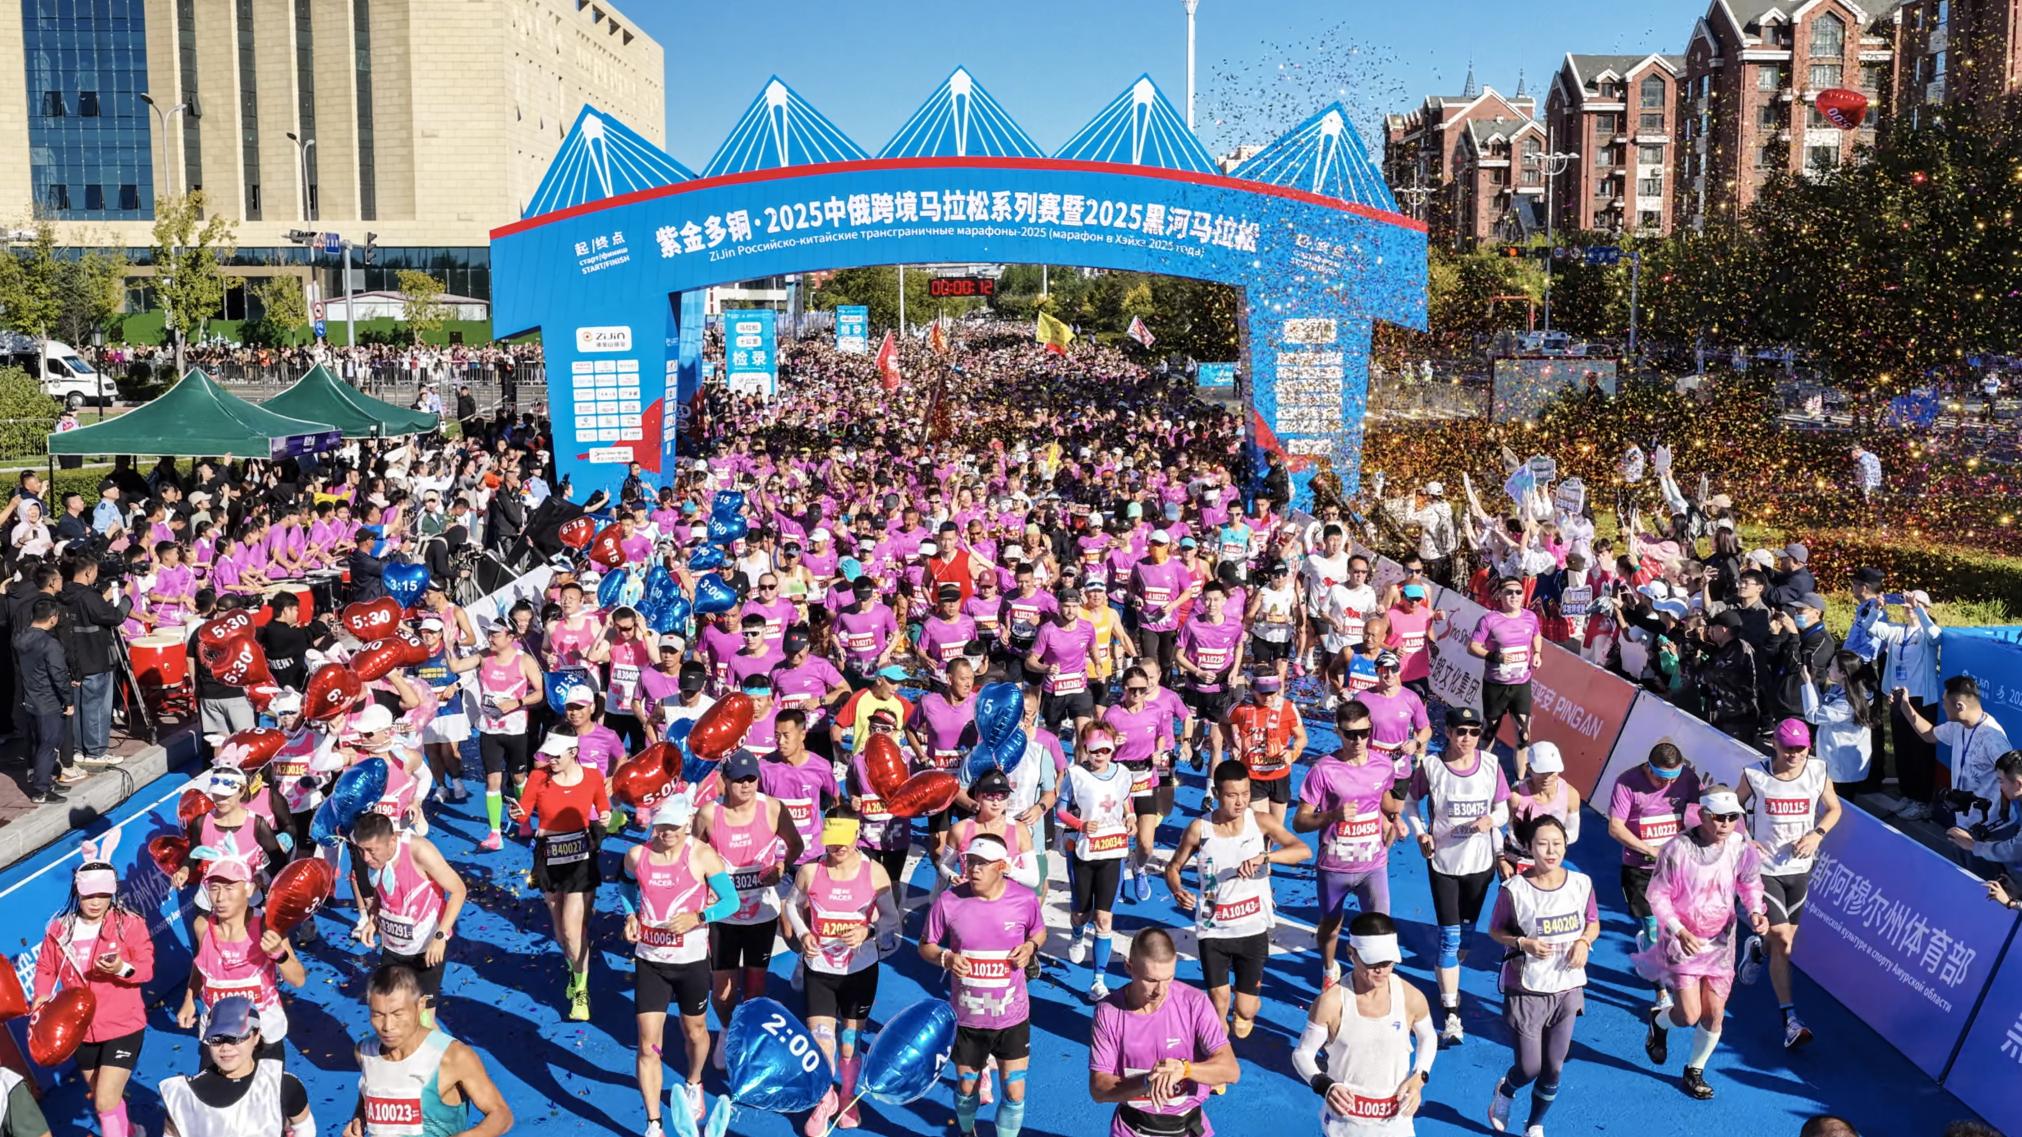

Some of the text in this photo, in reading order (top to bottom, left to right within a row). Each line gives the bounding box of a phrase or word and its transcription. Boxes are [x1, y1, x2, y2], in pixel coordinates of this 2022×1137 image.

[709, 248, 735, 263] ZiJin
[737, 231, 858, 256] Российско-китайские
[861, 226, 954, 241] трансграничные
[582, 255, 631, 275] START/FINISH
[931, 279, 994, 296] 00:00:12
[389, 579, 418, 591] 3:15
[700, 579, 722, 600] 3:00
[211, 614, 249, 639] 5:30
[351, 609, 391, 630] 5:30
[223, 651, 254, 683] 5:30
[643, 775, 680, 805] 5:00
[1771, 800, 1805, 814] A10115
[1222, 901, 1255, 919] A10143
[1809, 849, 1977, 988] 斯阿穆尔州体育部
[1871, 949, 1894, 972] спорту
[761, 1013, 820, 1073] 2:00
[367, 1102, 413, 1122] A10023
